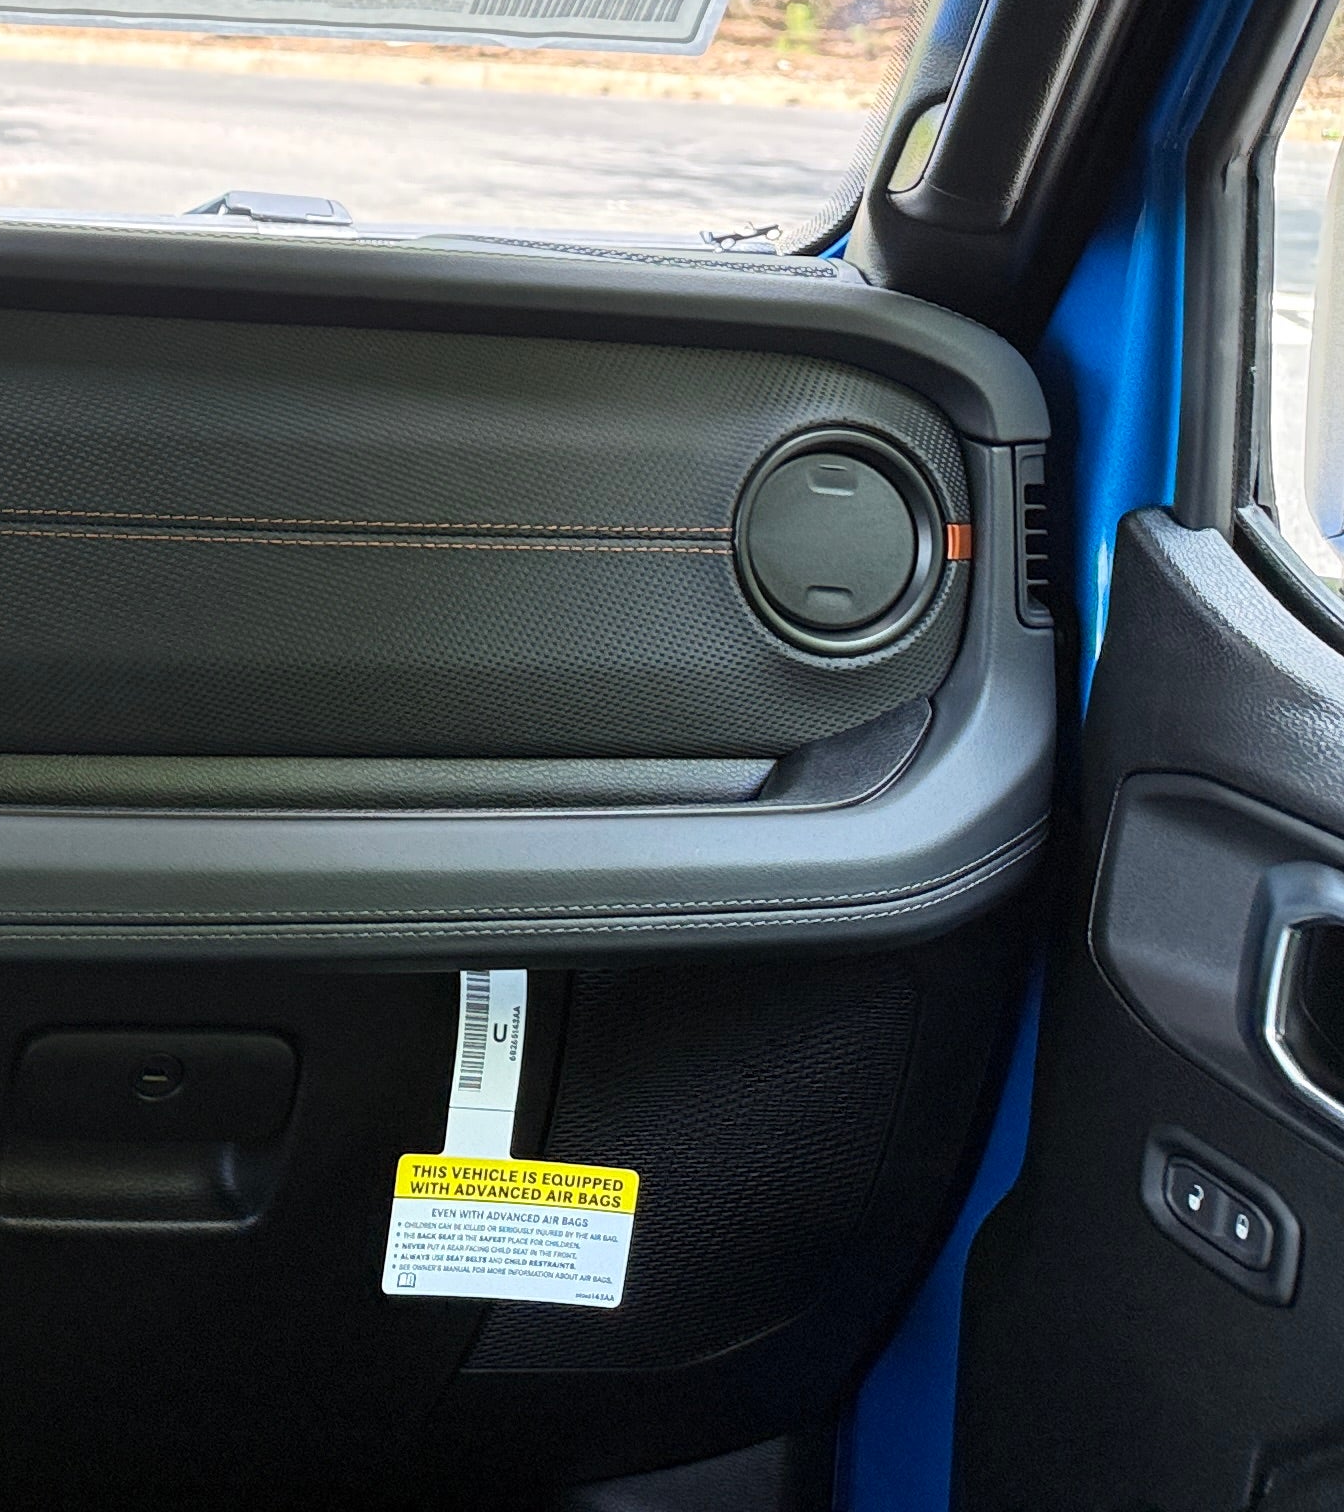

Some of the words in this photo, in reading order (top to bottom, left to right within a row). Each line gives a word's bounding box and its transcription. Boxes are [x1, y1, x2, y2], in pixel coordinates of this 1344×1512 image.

[493, 1023, 508, 1043] U
[412, 1165, 447, 1178] THIS
[451, 1167, 518, 1183] VEHICLE
[522, 1172, 537, 1183] IS
[542, 1172, 624, 1192] EQUIPPED
[410, 1180, 450, 1195] WITH
[454, 1184, 542, 1200] ADVANCED
[546, 1189, 572, 1203] AIR
[578, 1193, 621, 1208] BAGS
[432, 1208, 457, 1218] EVEN
[460, 1210, 484, 1219] WITH
[486, 1210, 540, 1223] ADVANCED
[542, 1216, 559, 1225] AIR
[562, 1217, 589, 1228] BAGS
[404, 1221, 436, 1229] CHILDREN
[438, 1222, 452, 1230] CAN
[463, 1223, 486, 1232] KILLED
[498, 1226, 534, 1235] SERIOUSLY
[565, 1229, 574, 1238] BY
[575, 1230, 589, 1239] THE
[590, 1232, 601, 1240] AIR
